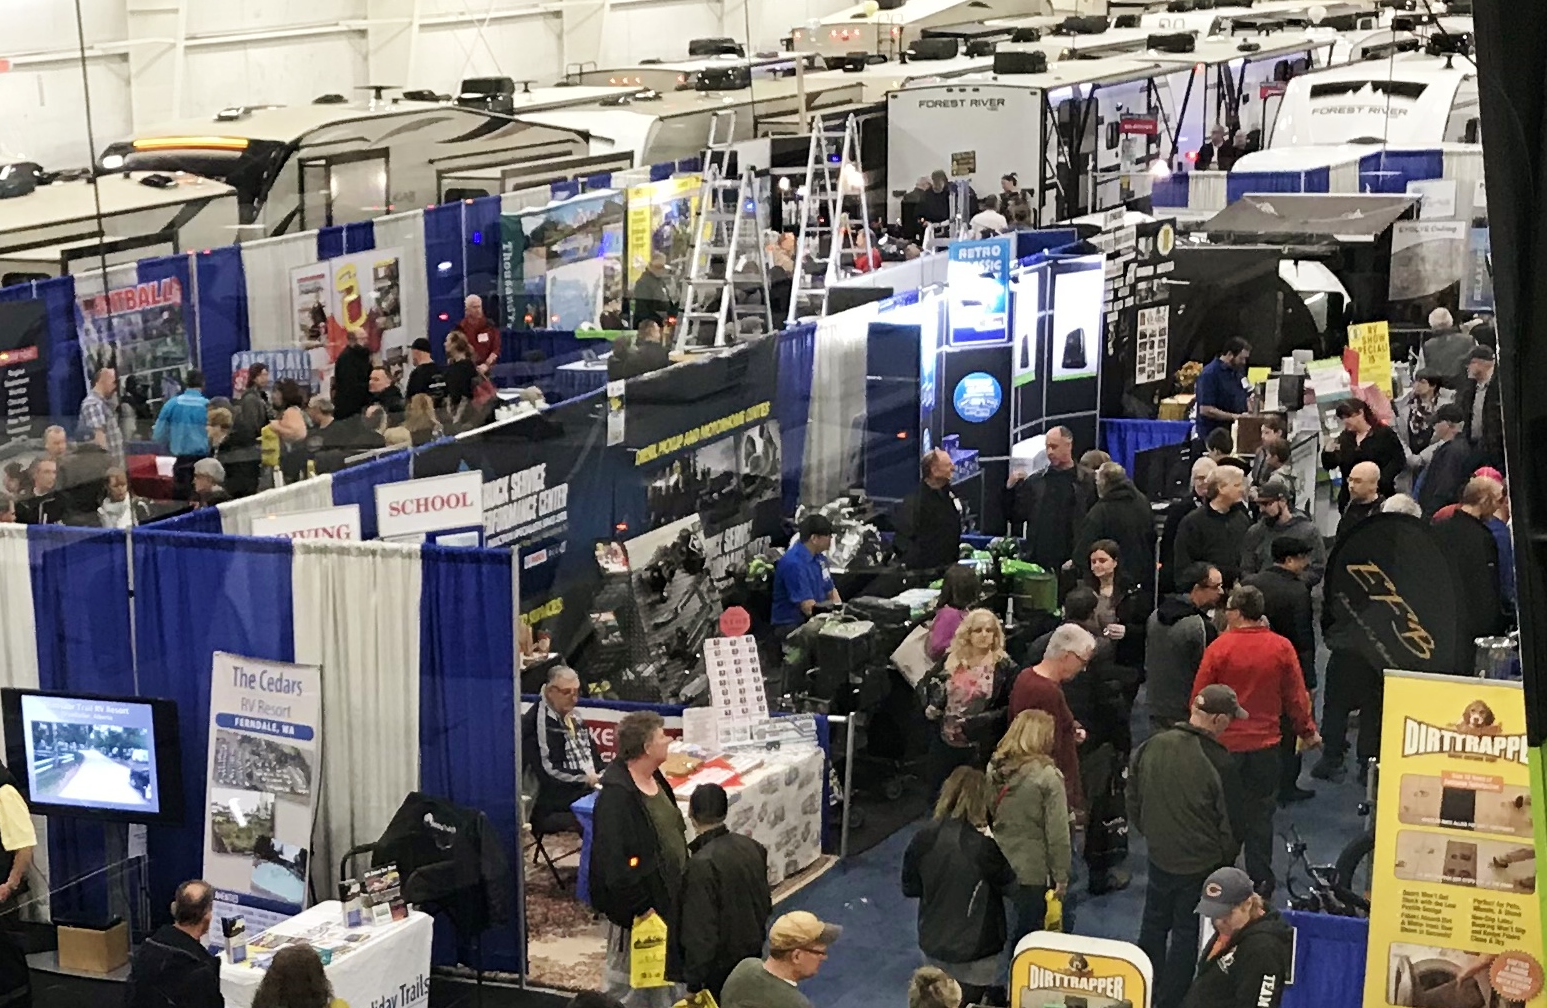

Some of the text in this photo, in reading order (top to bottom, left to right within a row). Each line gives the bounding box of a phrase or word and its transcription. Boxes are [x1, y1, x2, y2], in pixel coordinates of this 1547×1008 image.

[919, 98, 1005, 108] FOREST RIVER
[1311, 106, 1408, 116] FOREST RIVER
[958, 245, 1001, 259] RETRO
[388, 492, 474, 517] SCHOOL
[232, 666, 302, 696] The Cedars
[106, 705, 129, 715] Resort
[240, 697, 291, 718] RV Resort
[234, 717, 295, 736] FERNDALE, WA
[1404, 718, 1529, 765] DIRTTRAPPE
[399, 974, 431, 1007] Trails
[1029, 964, 1124, 1001] DIRTTRAPPER
